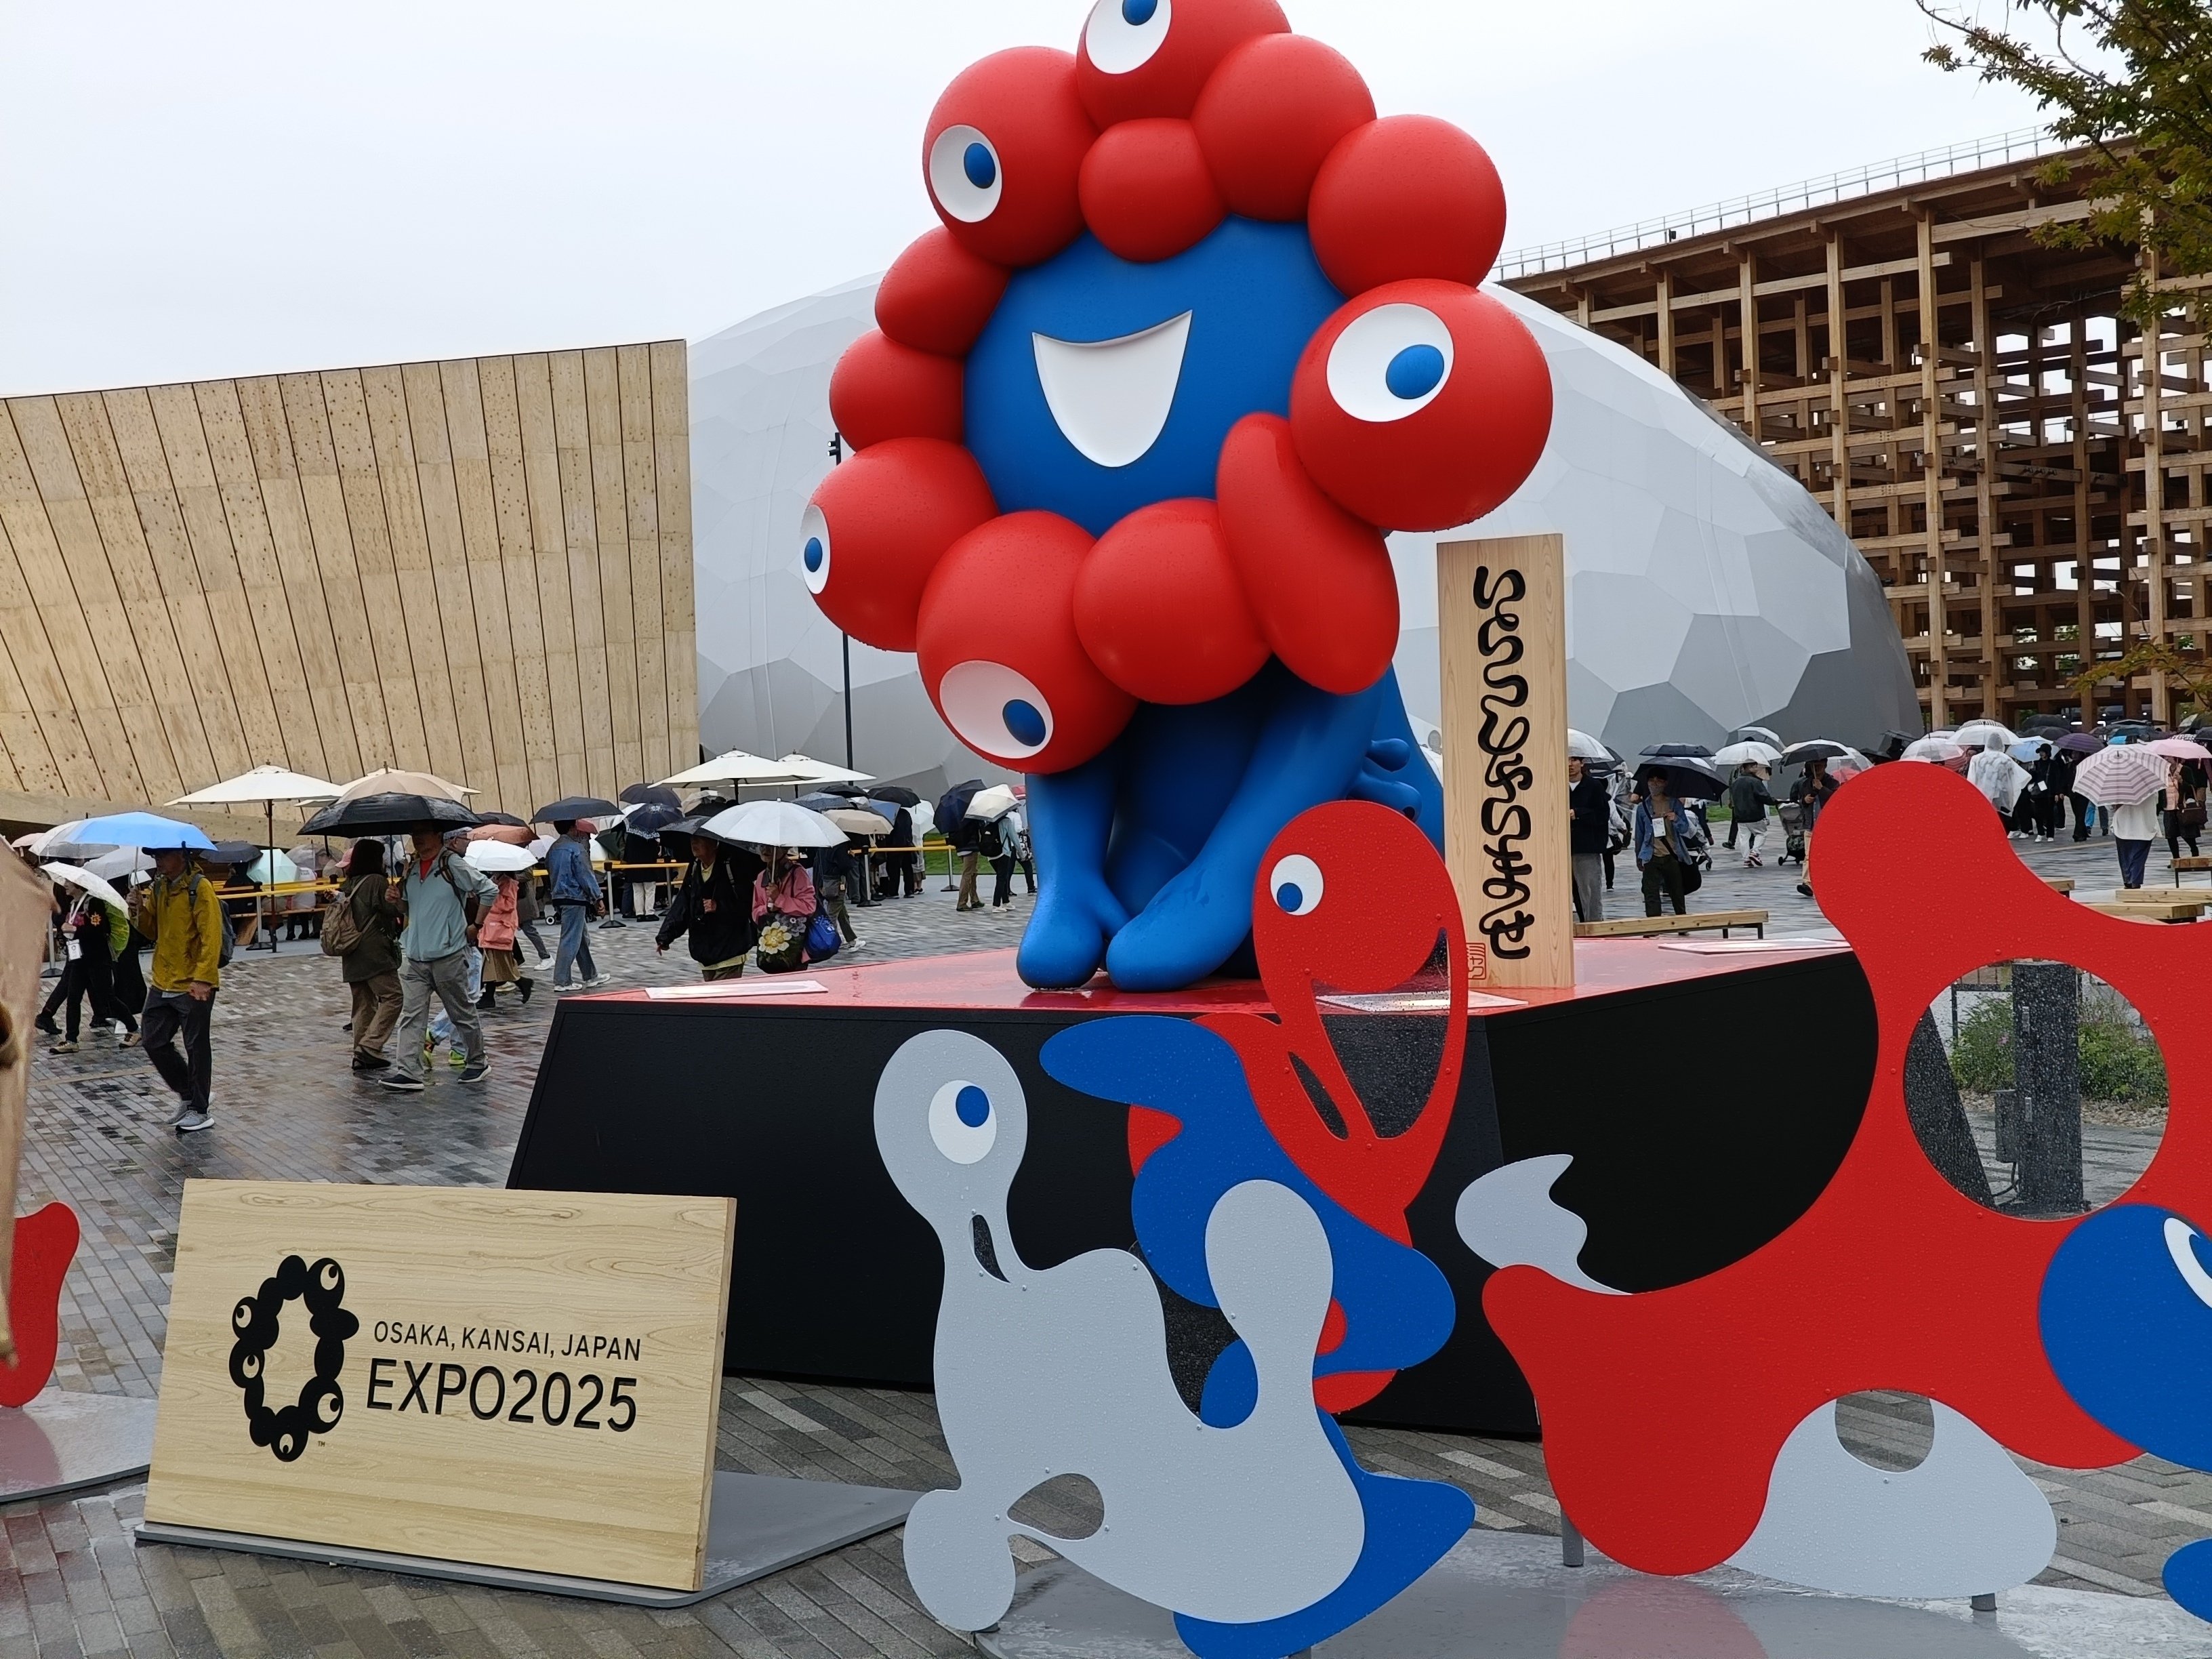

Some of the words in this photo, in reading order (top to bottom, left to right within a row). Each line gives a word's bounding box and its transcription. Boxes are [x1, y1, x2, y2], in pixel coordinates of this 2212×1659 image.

[1473, 565, 1535, 960] いらっしゃいませ
[374, 1321, 455, 1351] OSAKA,
[462, 1327, 554, 1359] KANSAI,
[561, 1334, 641, 1361] JAPAN
[367, 1357, 638, 1433] EXPO2025
